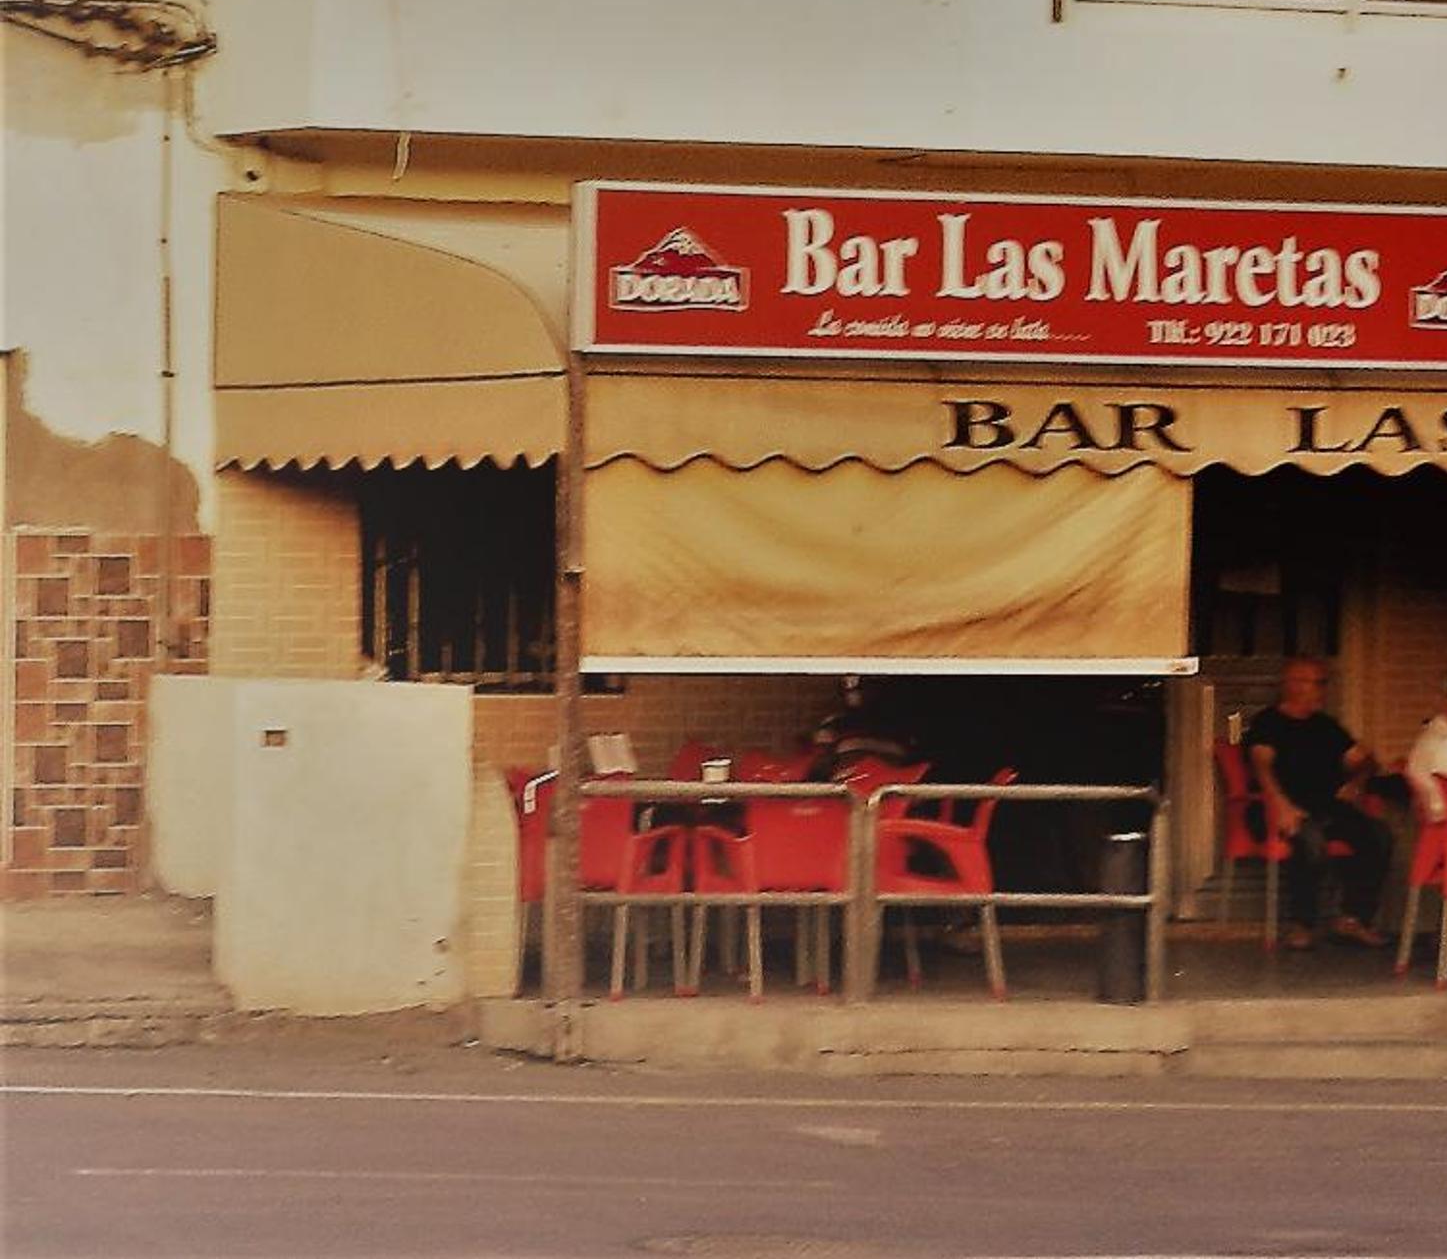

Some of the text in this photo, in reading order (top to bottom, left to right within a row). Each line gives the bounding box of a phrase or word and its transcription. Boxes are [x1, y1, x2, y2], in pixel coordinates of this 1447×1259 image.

[781, 209, 1381, 308] Bar Las Maretas
[942, 400, 1193, 453] BAR
